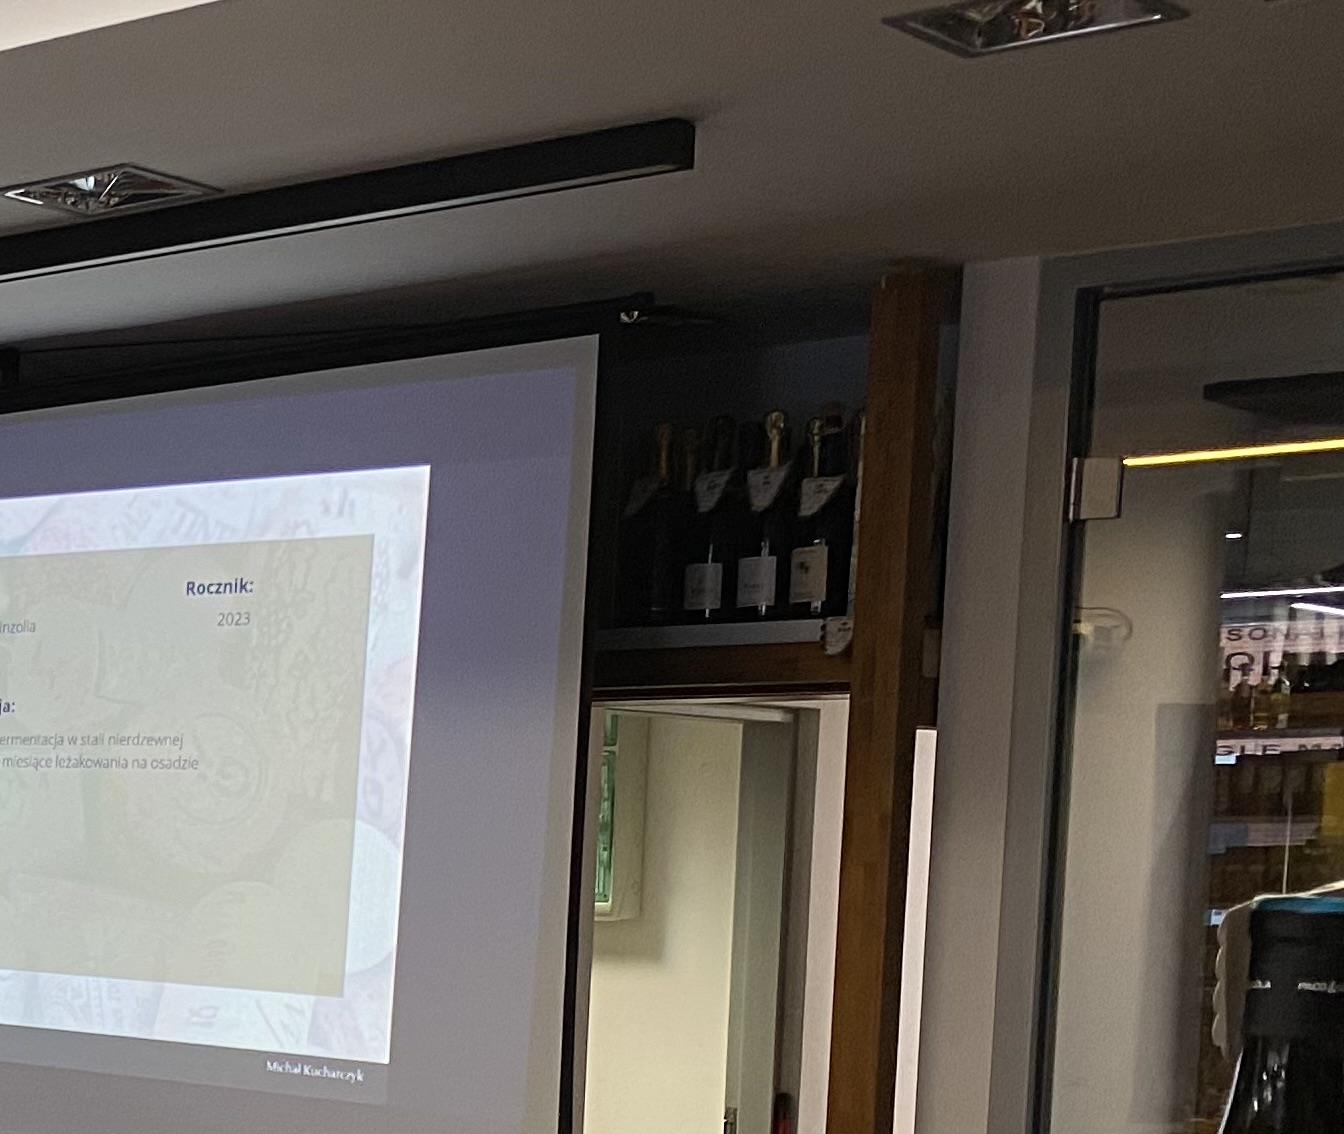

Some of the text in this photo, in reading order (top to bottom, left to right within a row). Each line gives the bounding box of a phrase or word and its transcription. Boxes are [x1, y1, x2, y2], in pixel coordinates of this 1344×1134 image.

[185, 578, 255, 597] Rocznik:
[216, 612, 252, 627] 2023
[66, 736, 79, 747] w
[80, 733, 106, 747] stali
[107, 732, 185, 751] nierdzewnej
[2, 756, 53, 773] miesiące
[55, 754, 129, 770] leżakowania
[131, 758, 149, 770] na
[150, 757, 200, 771] osadzie
